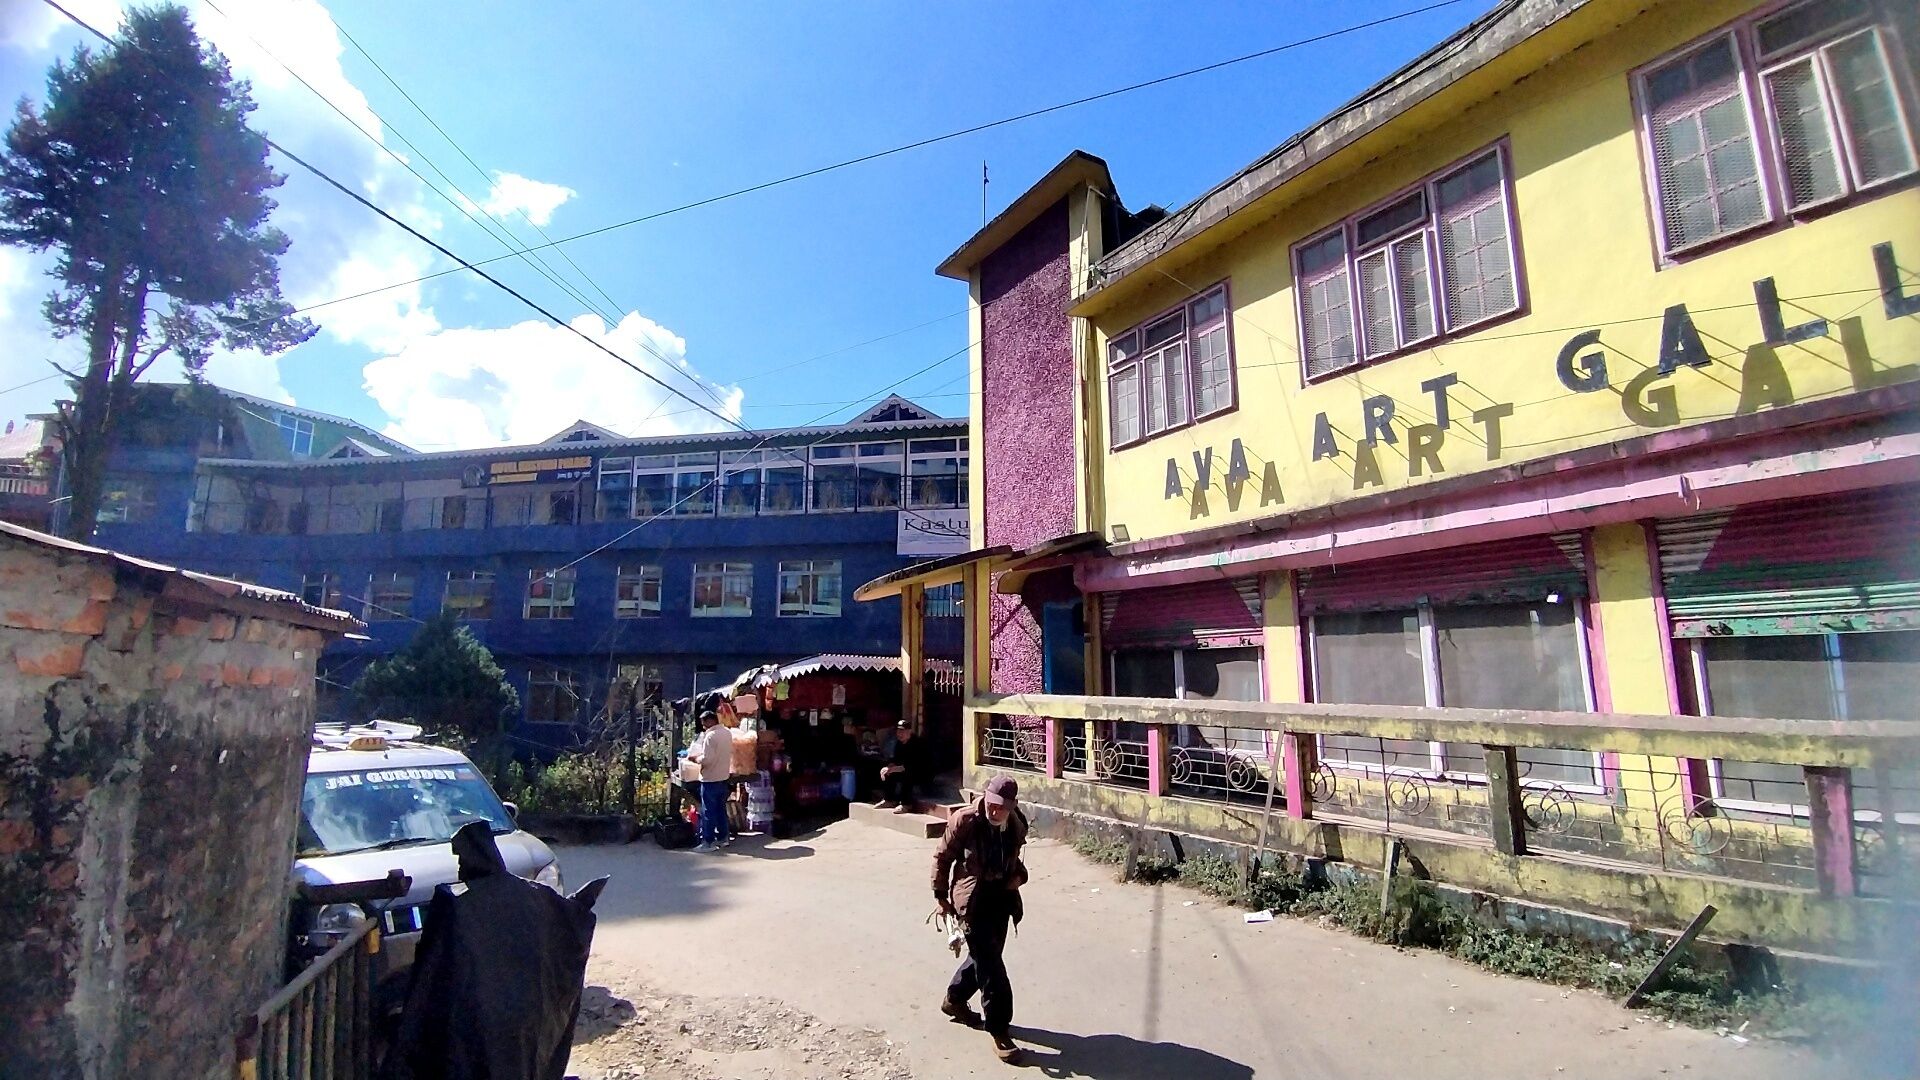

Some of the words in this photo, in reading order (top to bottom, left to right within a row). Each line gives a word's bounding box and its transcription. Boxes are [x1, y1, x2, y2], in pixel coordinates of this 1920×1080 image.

[1165, 438, 1250, 500] AVA
[1312, 371, 1458, 462] ART
[1556, 240, 1920, 393] GALL
[904, 517, 969, 531] Kastu
[325, 774, 362, 790] JAI
